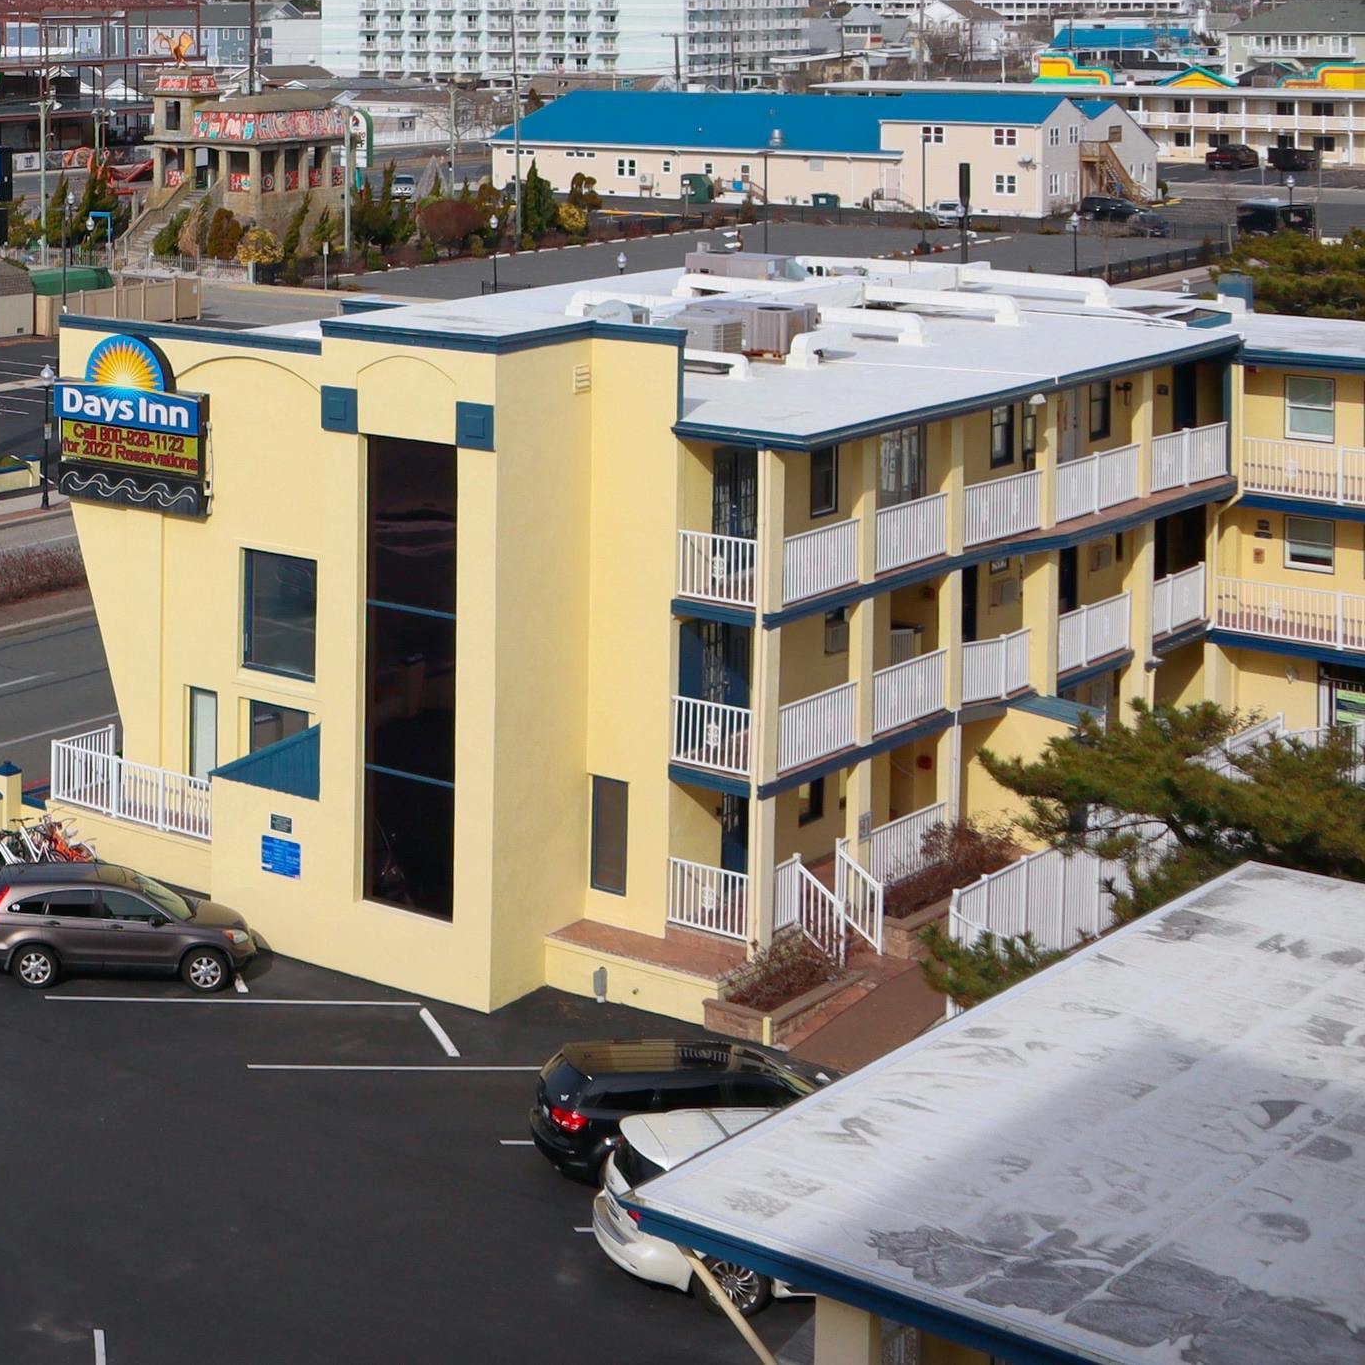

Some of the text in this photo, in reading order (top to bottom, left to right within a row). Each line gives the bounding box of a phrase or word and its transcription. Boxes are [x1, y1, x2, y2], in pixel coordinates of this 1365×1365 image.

[62, 387, 189, 428] Days Inn
[73, 423, 97, 440] Call
[62, 437, 198, 471] for 2022 Reservations
